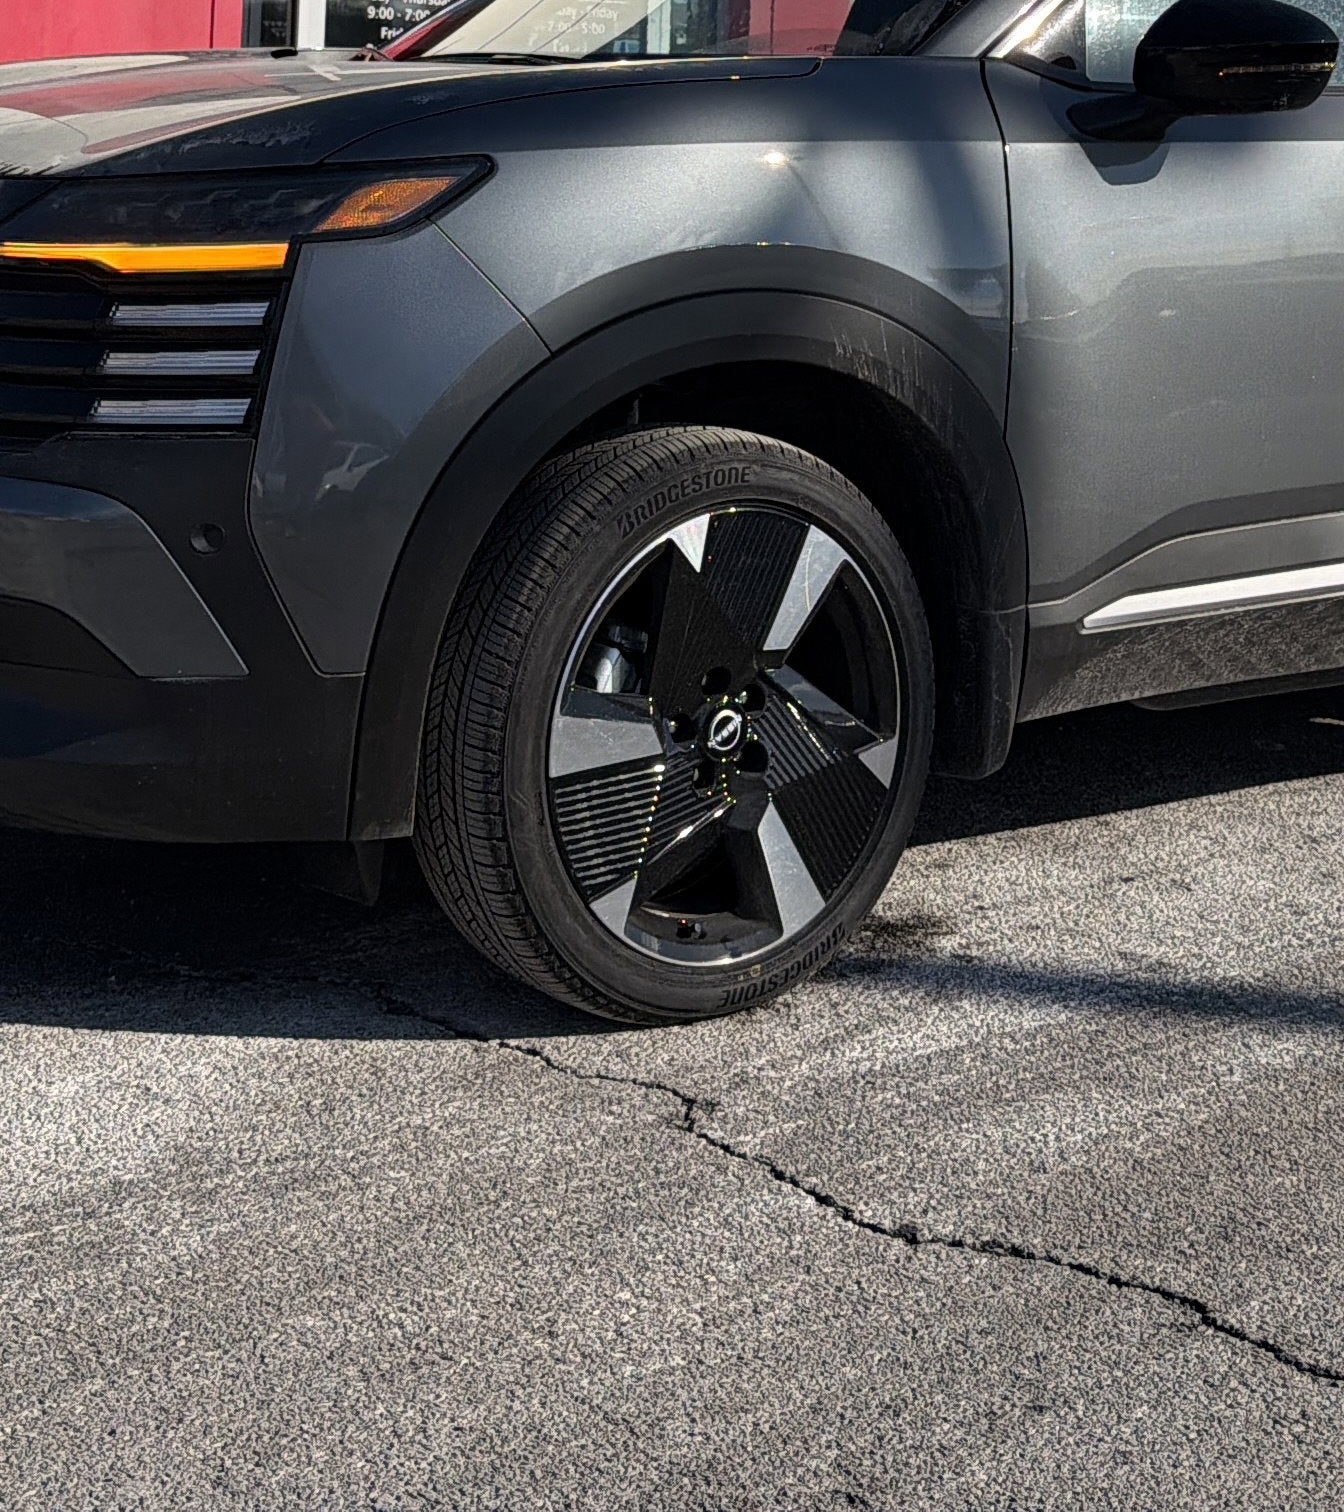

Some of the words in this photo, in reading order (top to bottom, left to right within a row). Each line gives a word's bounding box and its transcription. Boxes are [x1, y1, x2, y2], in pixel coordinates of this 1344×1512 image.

[367, 6, 394, 20] 9:00
[616, 466, 752, 538] BRIDGESTONE
[716, 921, 847, 1008] BRIDGESTONE
